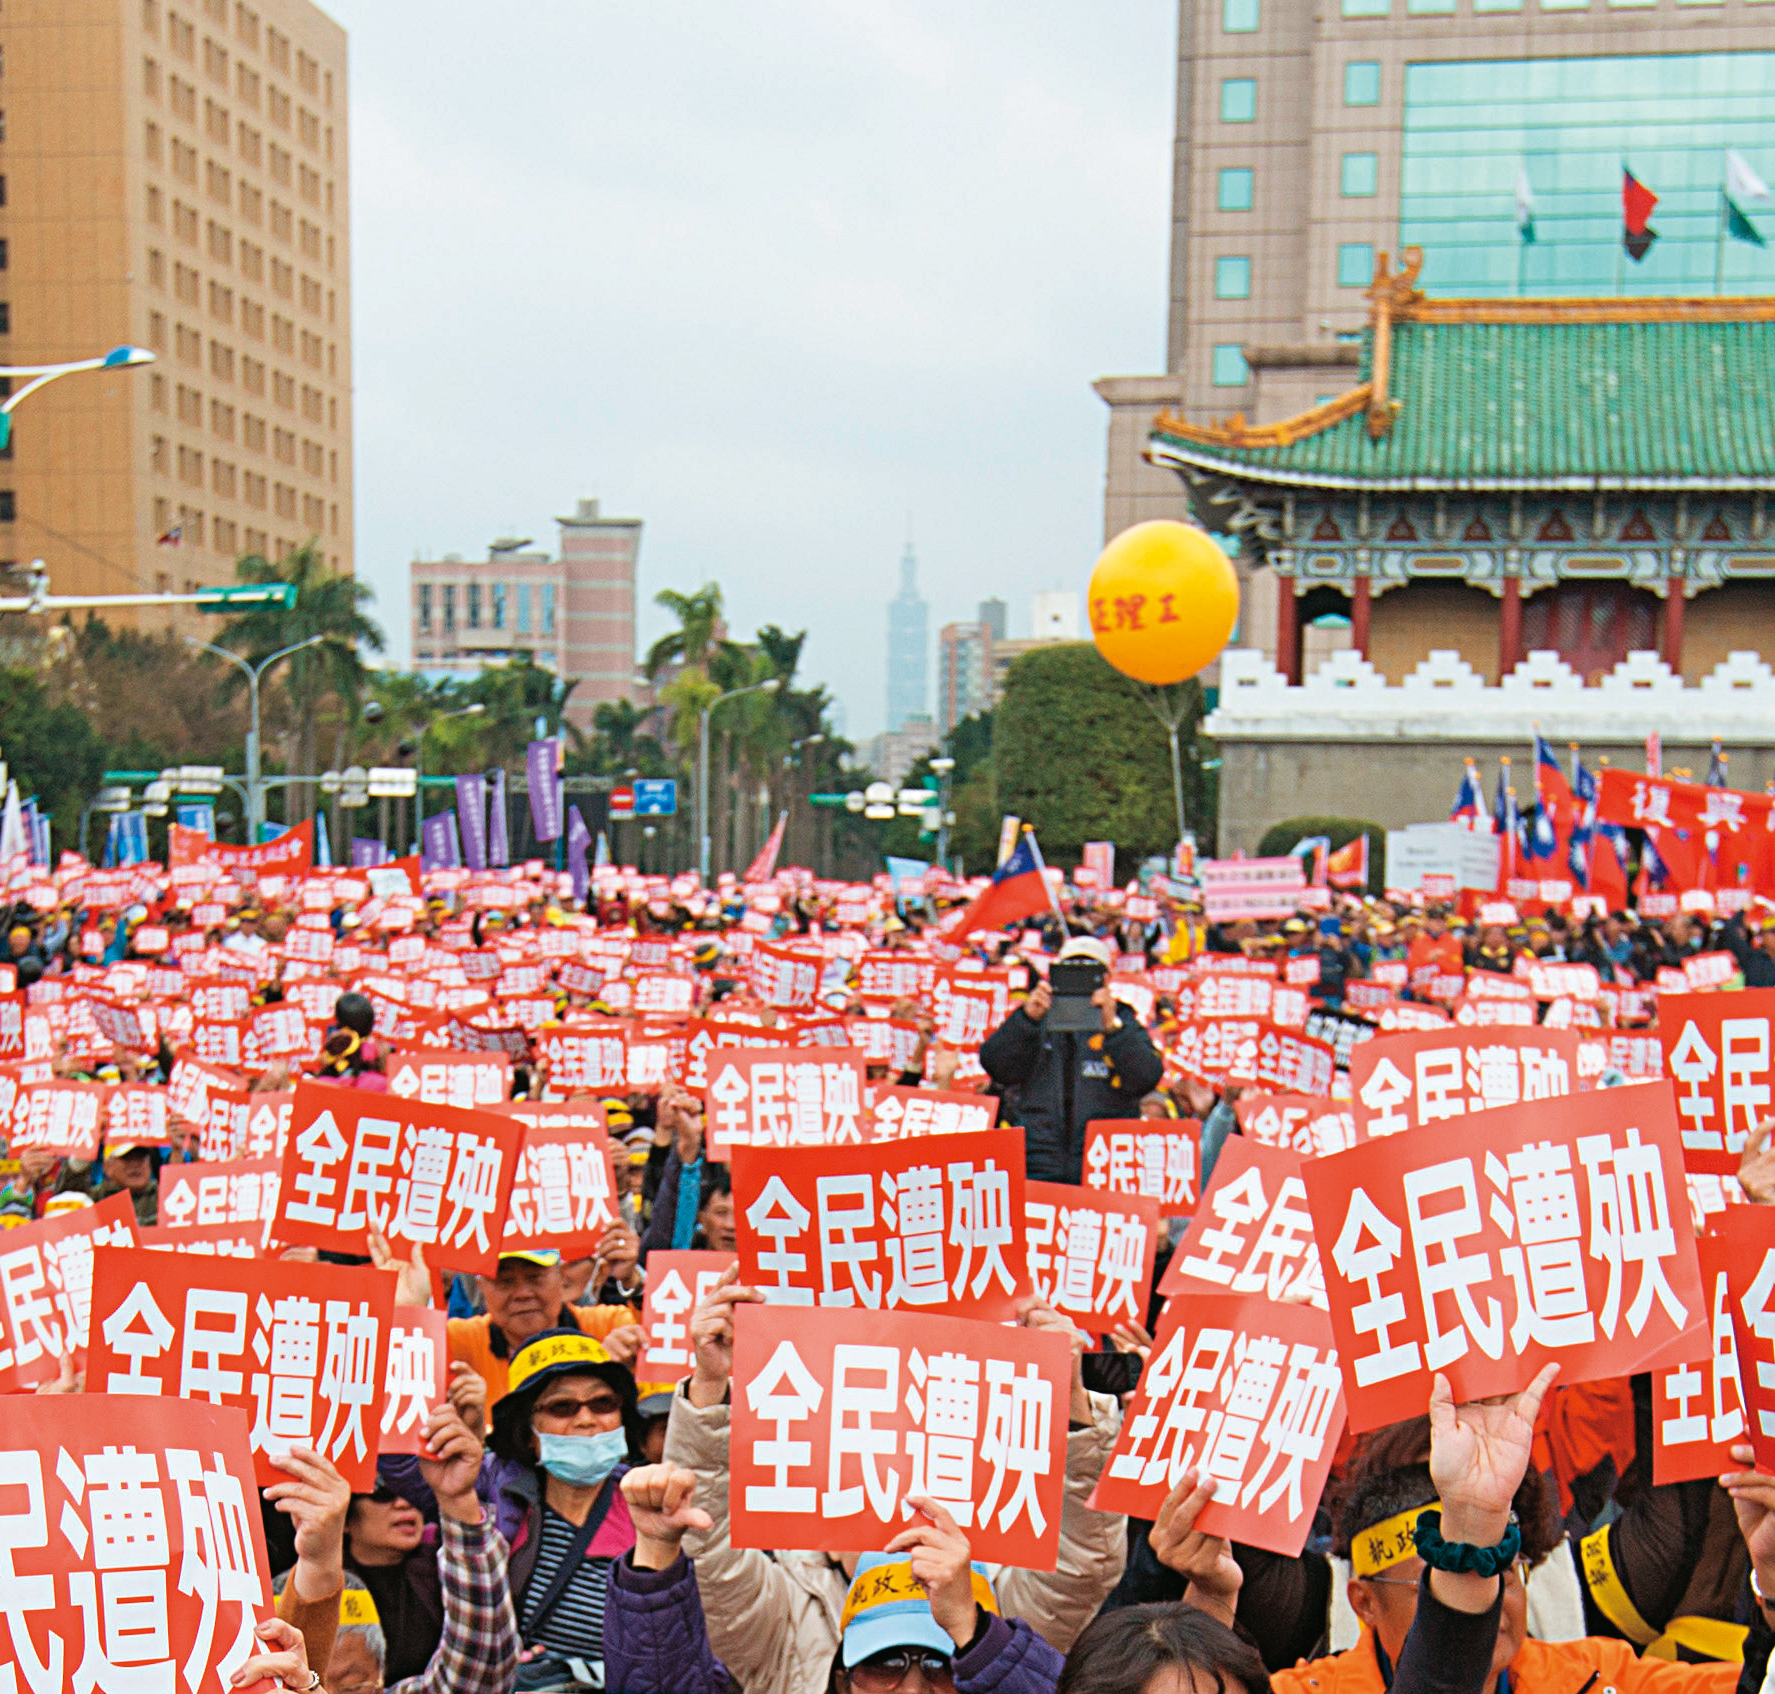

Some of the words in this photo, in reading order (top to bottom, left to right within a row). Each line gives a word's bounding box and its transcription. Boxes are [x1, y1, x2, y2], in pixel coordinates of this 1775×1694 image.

[9, 1089, 98, 1152] 全民遭殃
[548, 1034, 623, 1089] 全民遭殃
[711, 1062, 861, 1147] 全民遭殃
[285, 1109, 502, 1256] 全民遭殃
[508, 1141, 612, 1237] 遭殃
[745, 1160, 1017, 1310] 全民遭殃
[1086, 1132, 1196, 1205] 全民遭殃
[1180, 1165, 1329, 1312] 全民
[1331, 1128, 1689, 1388] 全民遭殃
[101, 1283, 381, 1466] 全民遭殃
[745, 1340, 1054, 1540] 全民遭殃
[1108, 1326, 1343, 1525] 全民遭殃
